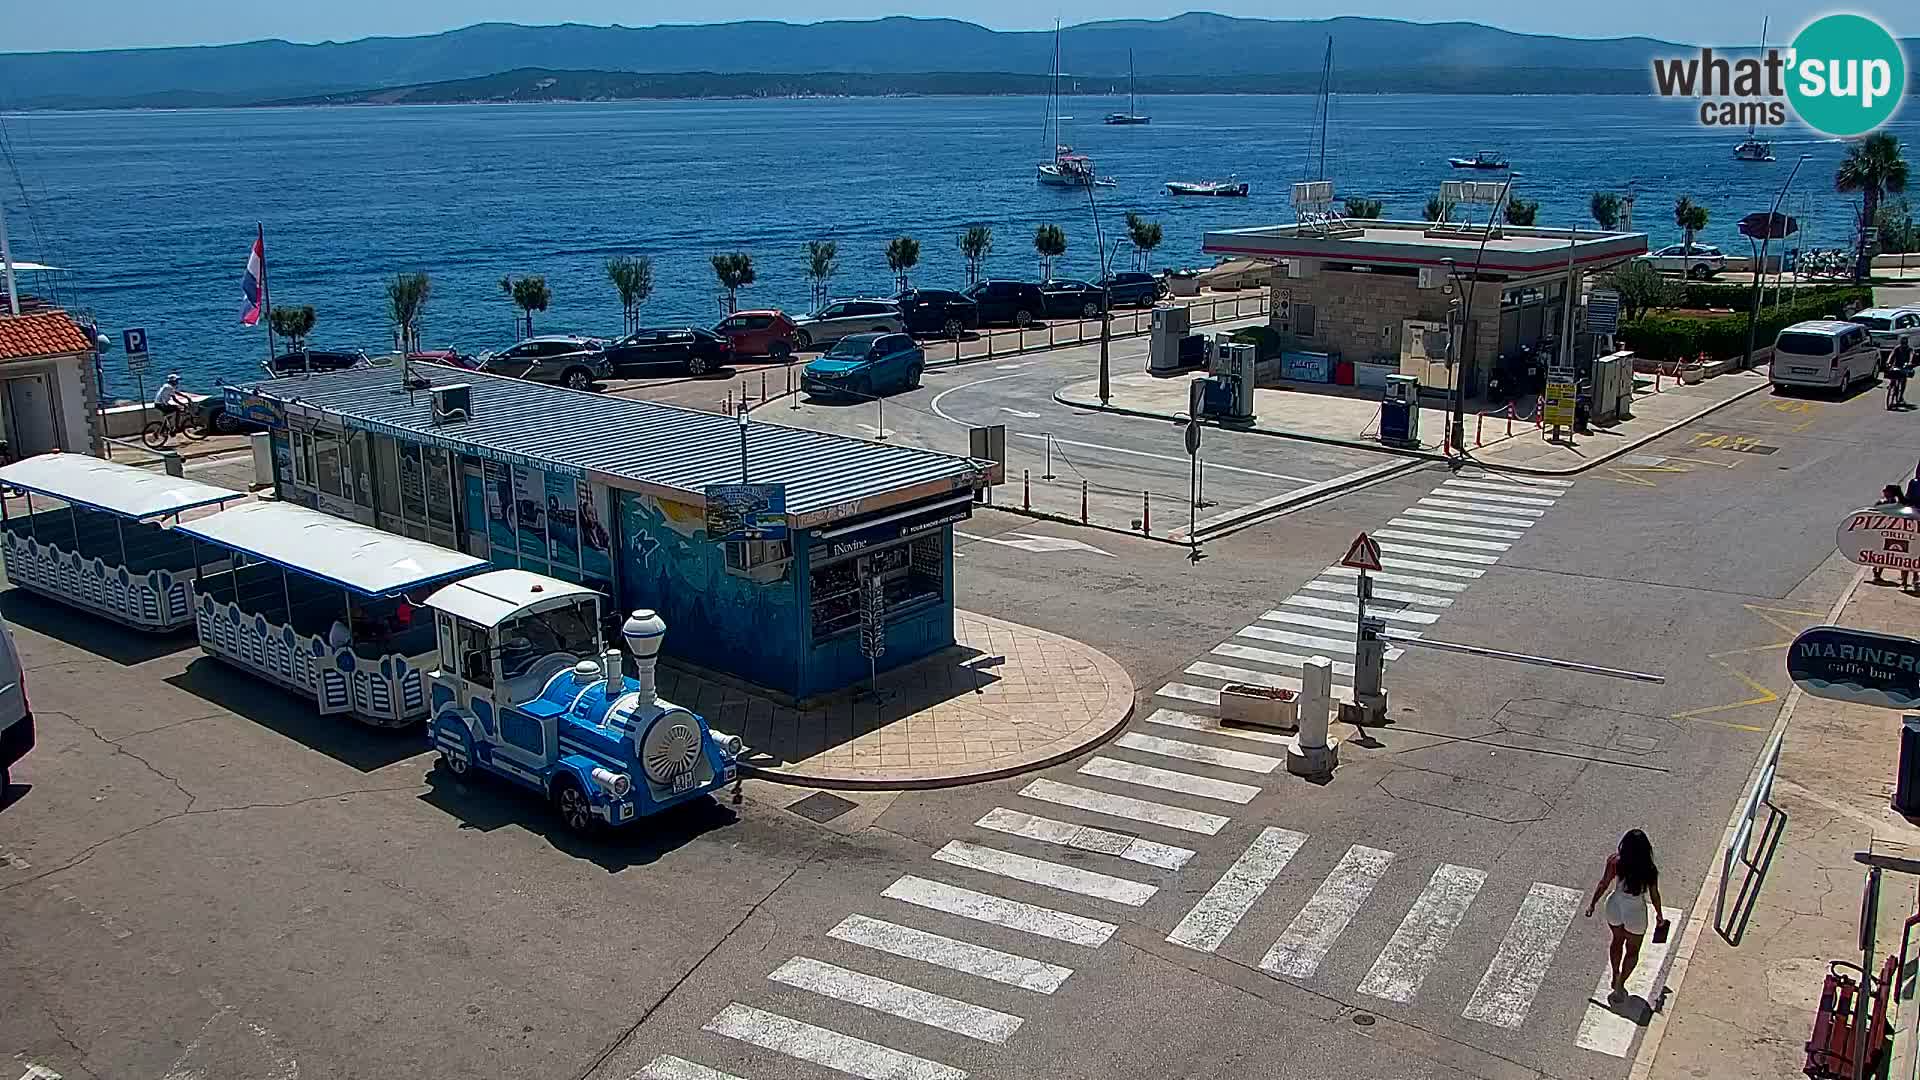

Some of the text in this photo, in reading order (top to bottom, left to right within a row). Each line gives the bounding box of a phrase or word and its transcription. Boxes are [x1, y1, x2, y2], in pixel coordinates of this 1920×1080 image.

[128, 331, 142, 350] P
[477, 446, 492, 458] BUS
[493, 450, 525, 465] STATION
[527, 457, 553, 471] TICKET
[554, 464, 581, 478] OFFICE
[1880, 530, 1916, 541] GRILL
[1828, 661, 1897, 680] caffe bar
